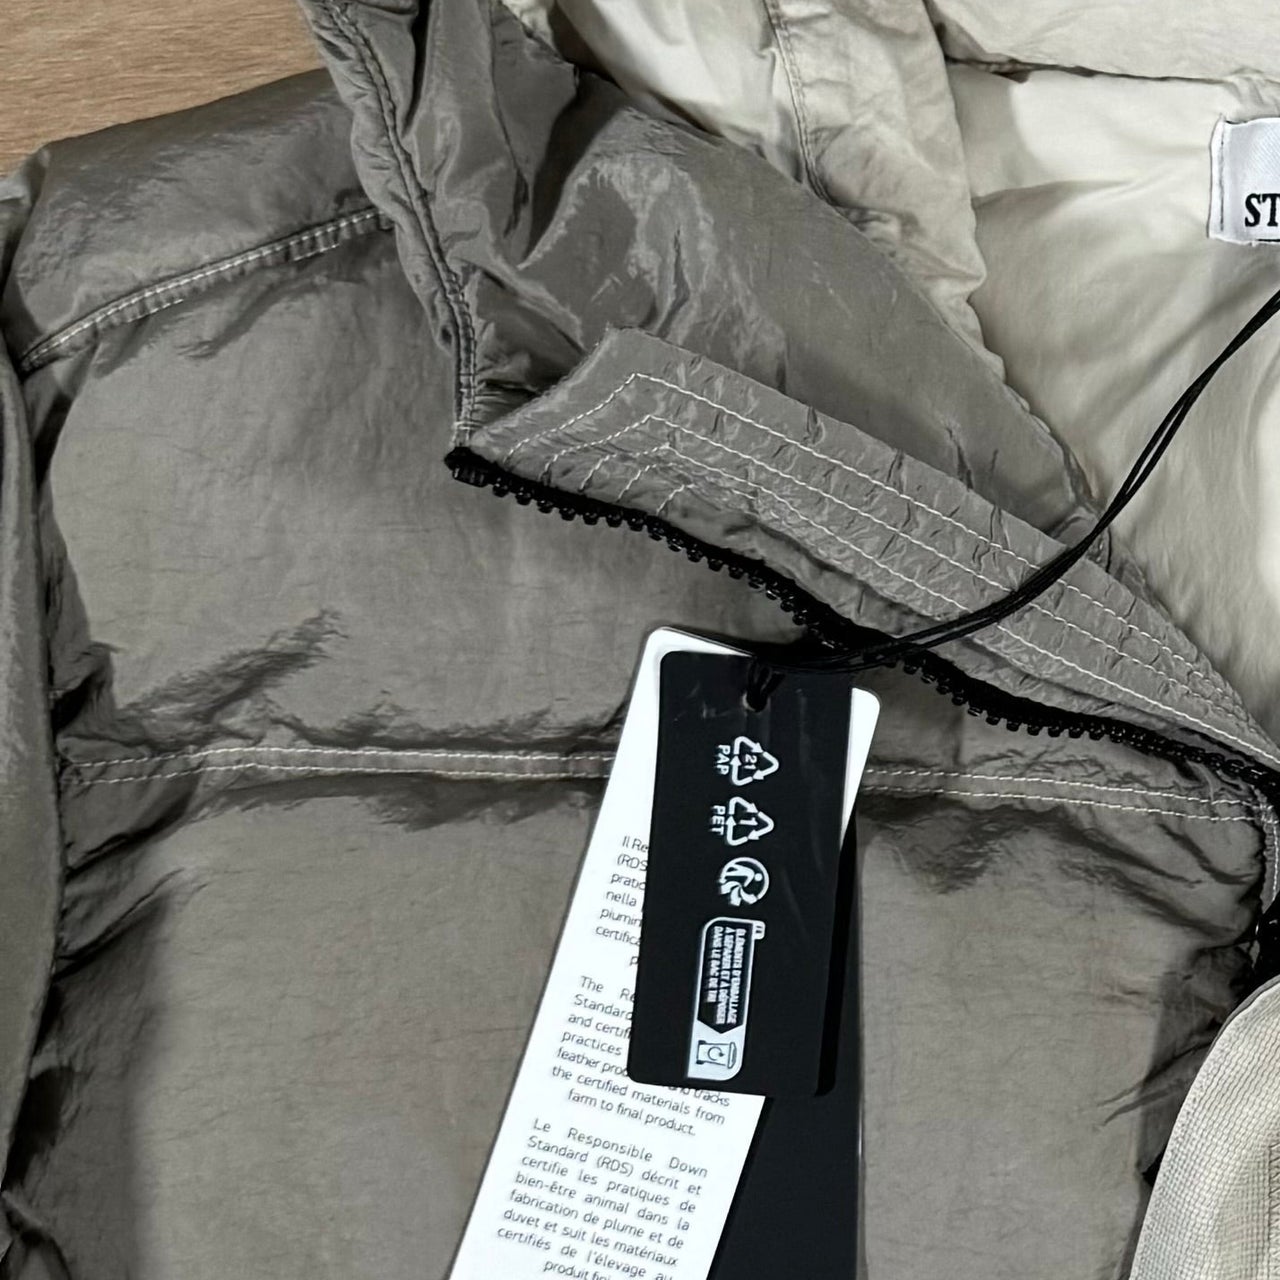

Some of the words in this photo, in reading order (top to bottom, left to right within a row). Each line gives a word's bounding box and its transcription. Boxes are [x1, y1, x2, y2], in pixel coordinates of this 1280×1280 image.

[716, 744, 731, 775] PAP
[711, 805, 726, 835] PET
[617, 854, 648, 872] (RDS
[610, 874, 646, 891] pratic
[606, 891, 637, 907] nella
[600, 909, 641, 928] piumin
[581, 976, 603, 992] The
[568, 1014, 593, 1027] and
[557, 1047, 600, 1068] feather
[561, 1032, 622, 1056] practices
[552, 1066, 572, 1080] the
[577, 1075, 628, 1096] certified
[632, 1091, 689, 1114] materials
[696, 1106, 725, 1124] from
[568, 1089, 597, 1107] farm
[601, 1100, 613, 1111] to
[617, 1103, 643, 1120] final
[533, 1118, 551, 1132] Le
[567, 1128, 652, 1162] Responsible
[669, 1157, 707, 1177] Down
[528, 1136, 588, 1162] Standard
[597, 1156, 633, 1177] (RDS)
[642, 1170, 679, 1189] décrit
[688, 1185, 701, 1195] et
[522, 1157, 568, 1176] certifie
[578, 1170, 597, 1185] les
[606, 1181, 669, 1205] pratiques
[680, 1201, 695, 1212] de
[510, 1189, 578, 1219] fabrication
[583, 1212, 599, 1224] de
[603, 1219, 644, 1237] plume
[649, 1232, 662, 1243] et
[668, 1236, 683, 1249] de
[584, 1194, 629, 1214] animal
[637, 1208, 667, 1225] dans
[677, 1217, 689, 1231] la
[497, 1228, 550, 1250] certifiés
[560, 1245, 577, 1257] de
[504, 1209, 540, 1227] duvet
[544, 1222, 558, 1232] et
[562, 1227, 586, 1241] suit
[591, 1232, 609, 1247] les
[614, 1242, 678, 1266] matériaux
[543, 1261, 589, 1280] produit
